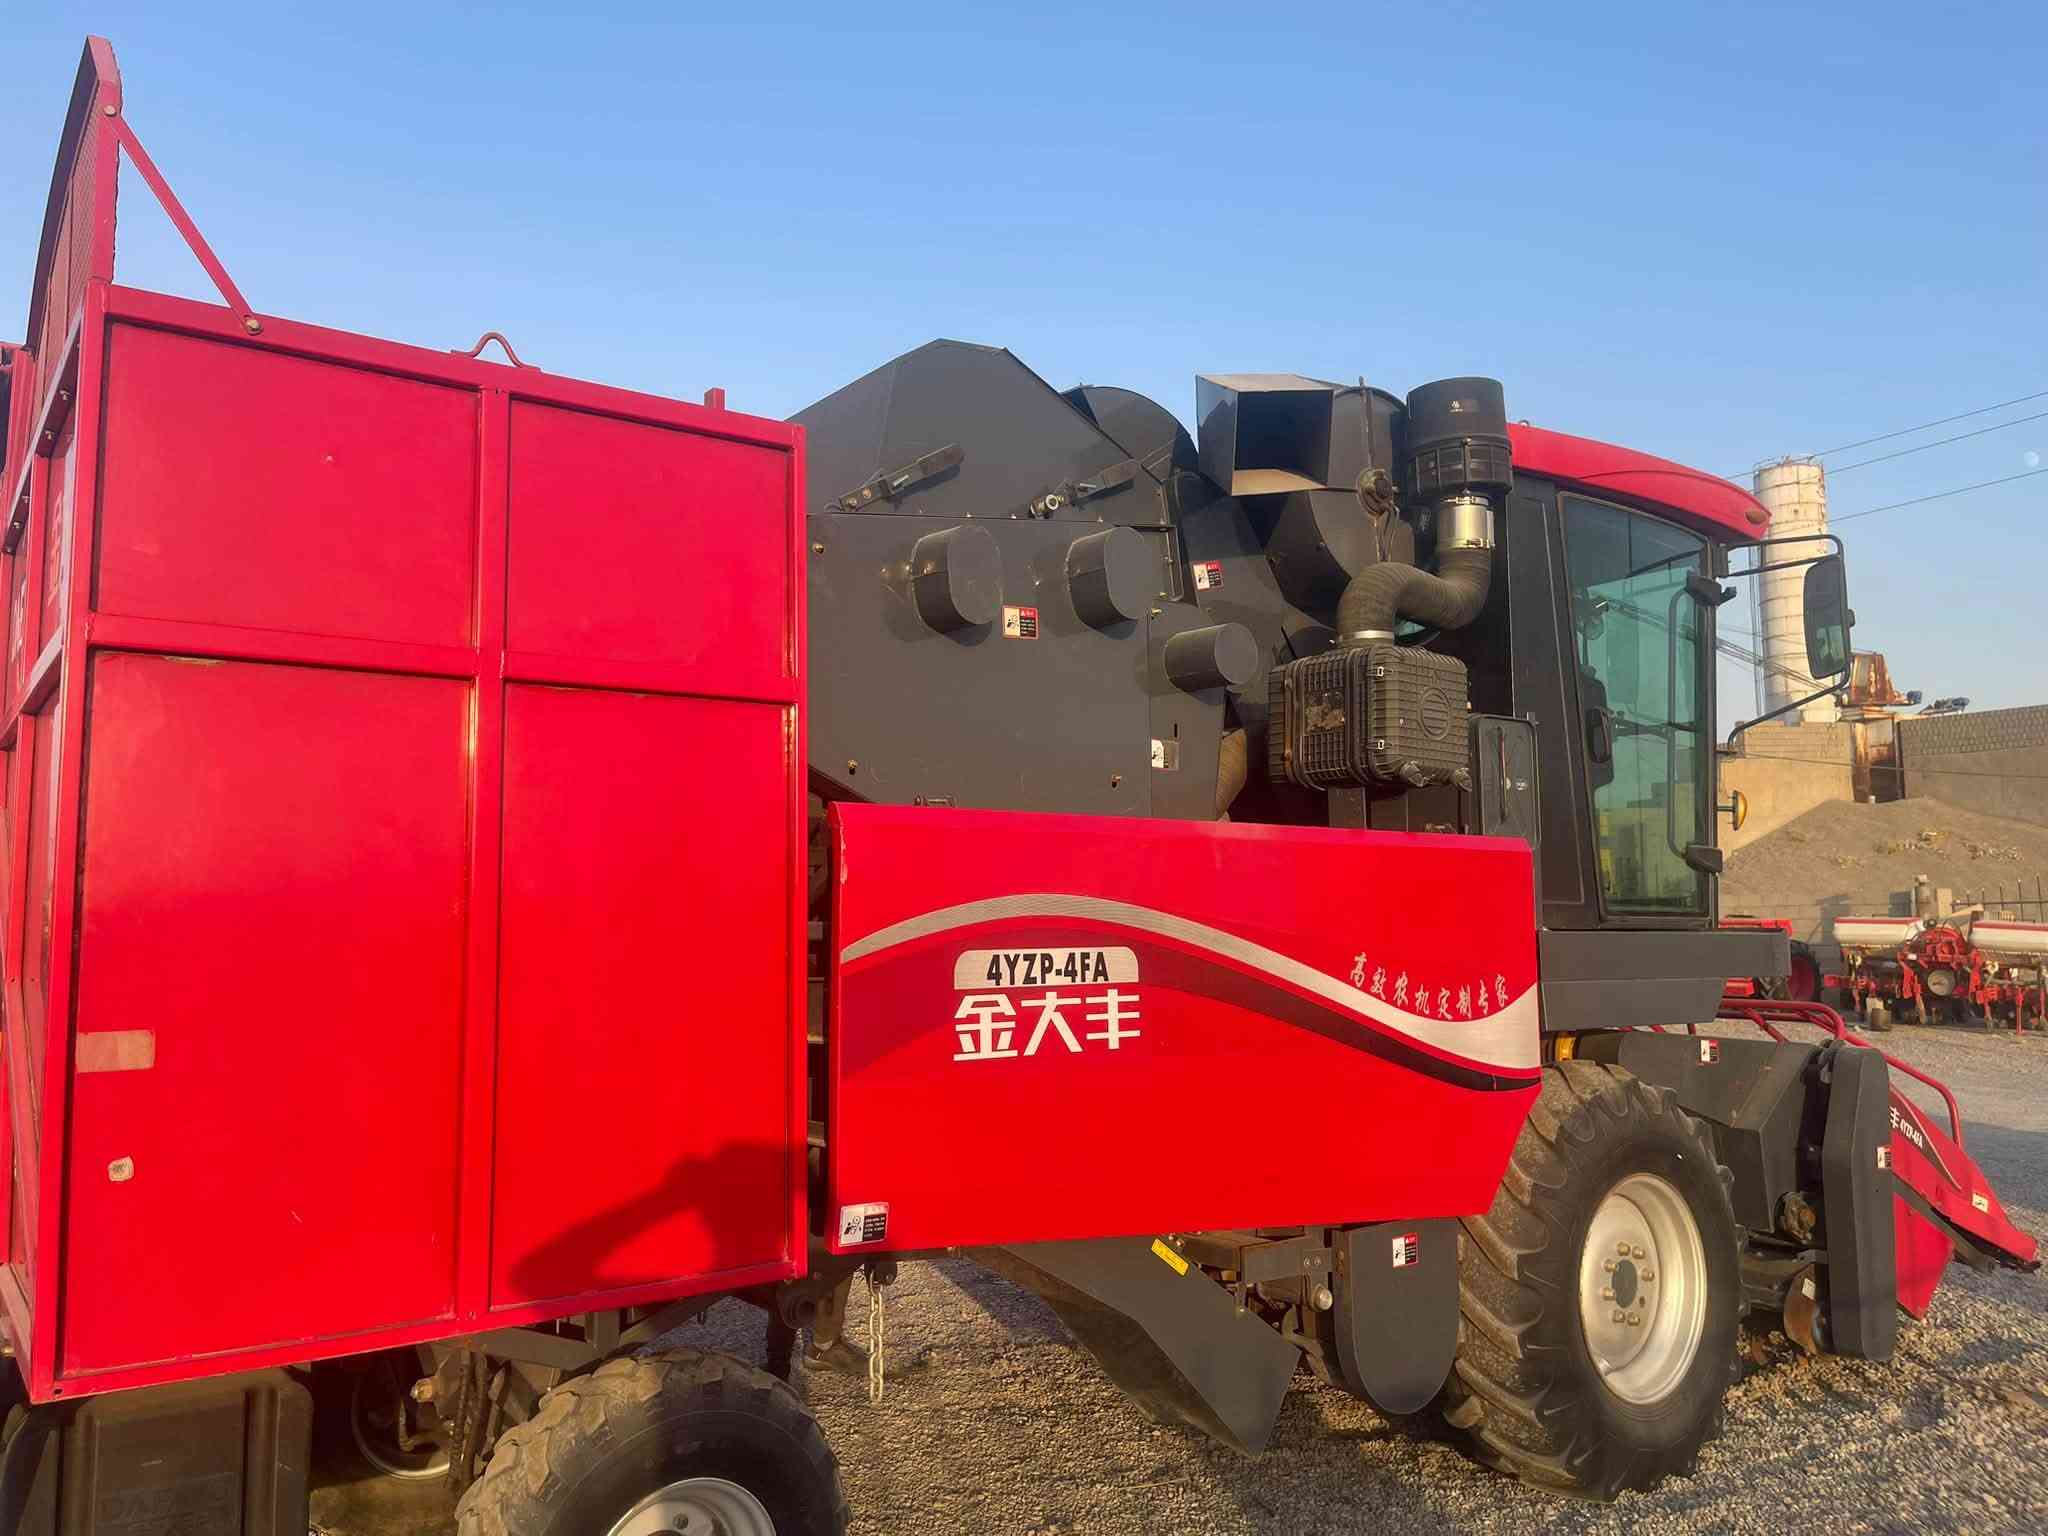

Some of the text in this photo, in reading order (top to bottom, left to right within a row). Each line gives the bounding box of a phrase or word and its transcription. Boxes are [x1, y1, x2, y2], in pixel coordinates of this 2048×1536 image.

[986, 951, 1109, 986] 4YZP-4FA
[1349, 951, 1509, 1020] 高效农机定制专家
[953, 988, 1141, 1062] 金大丰
